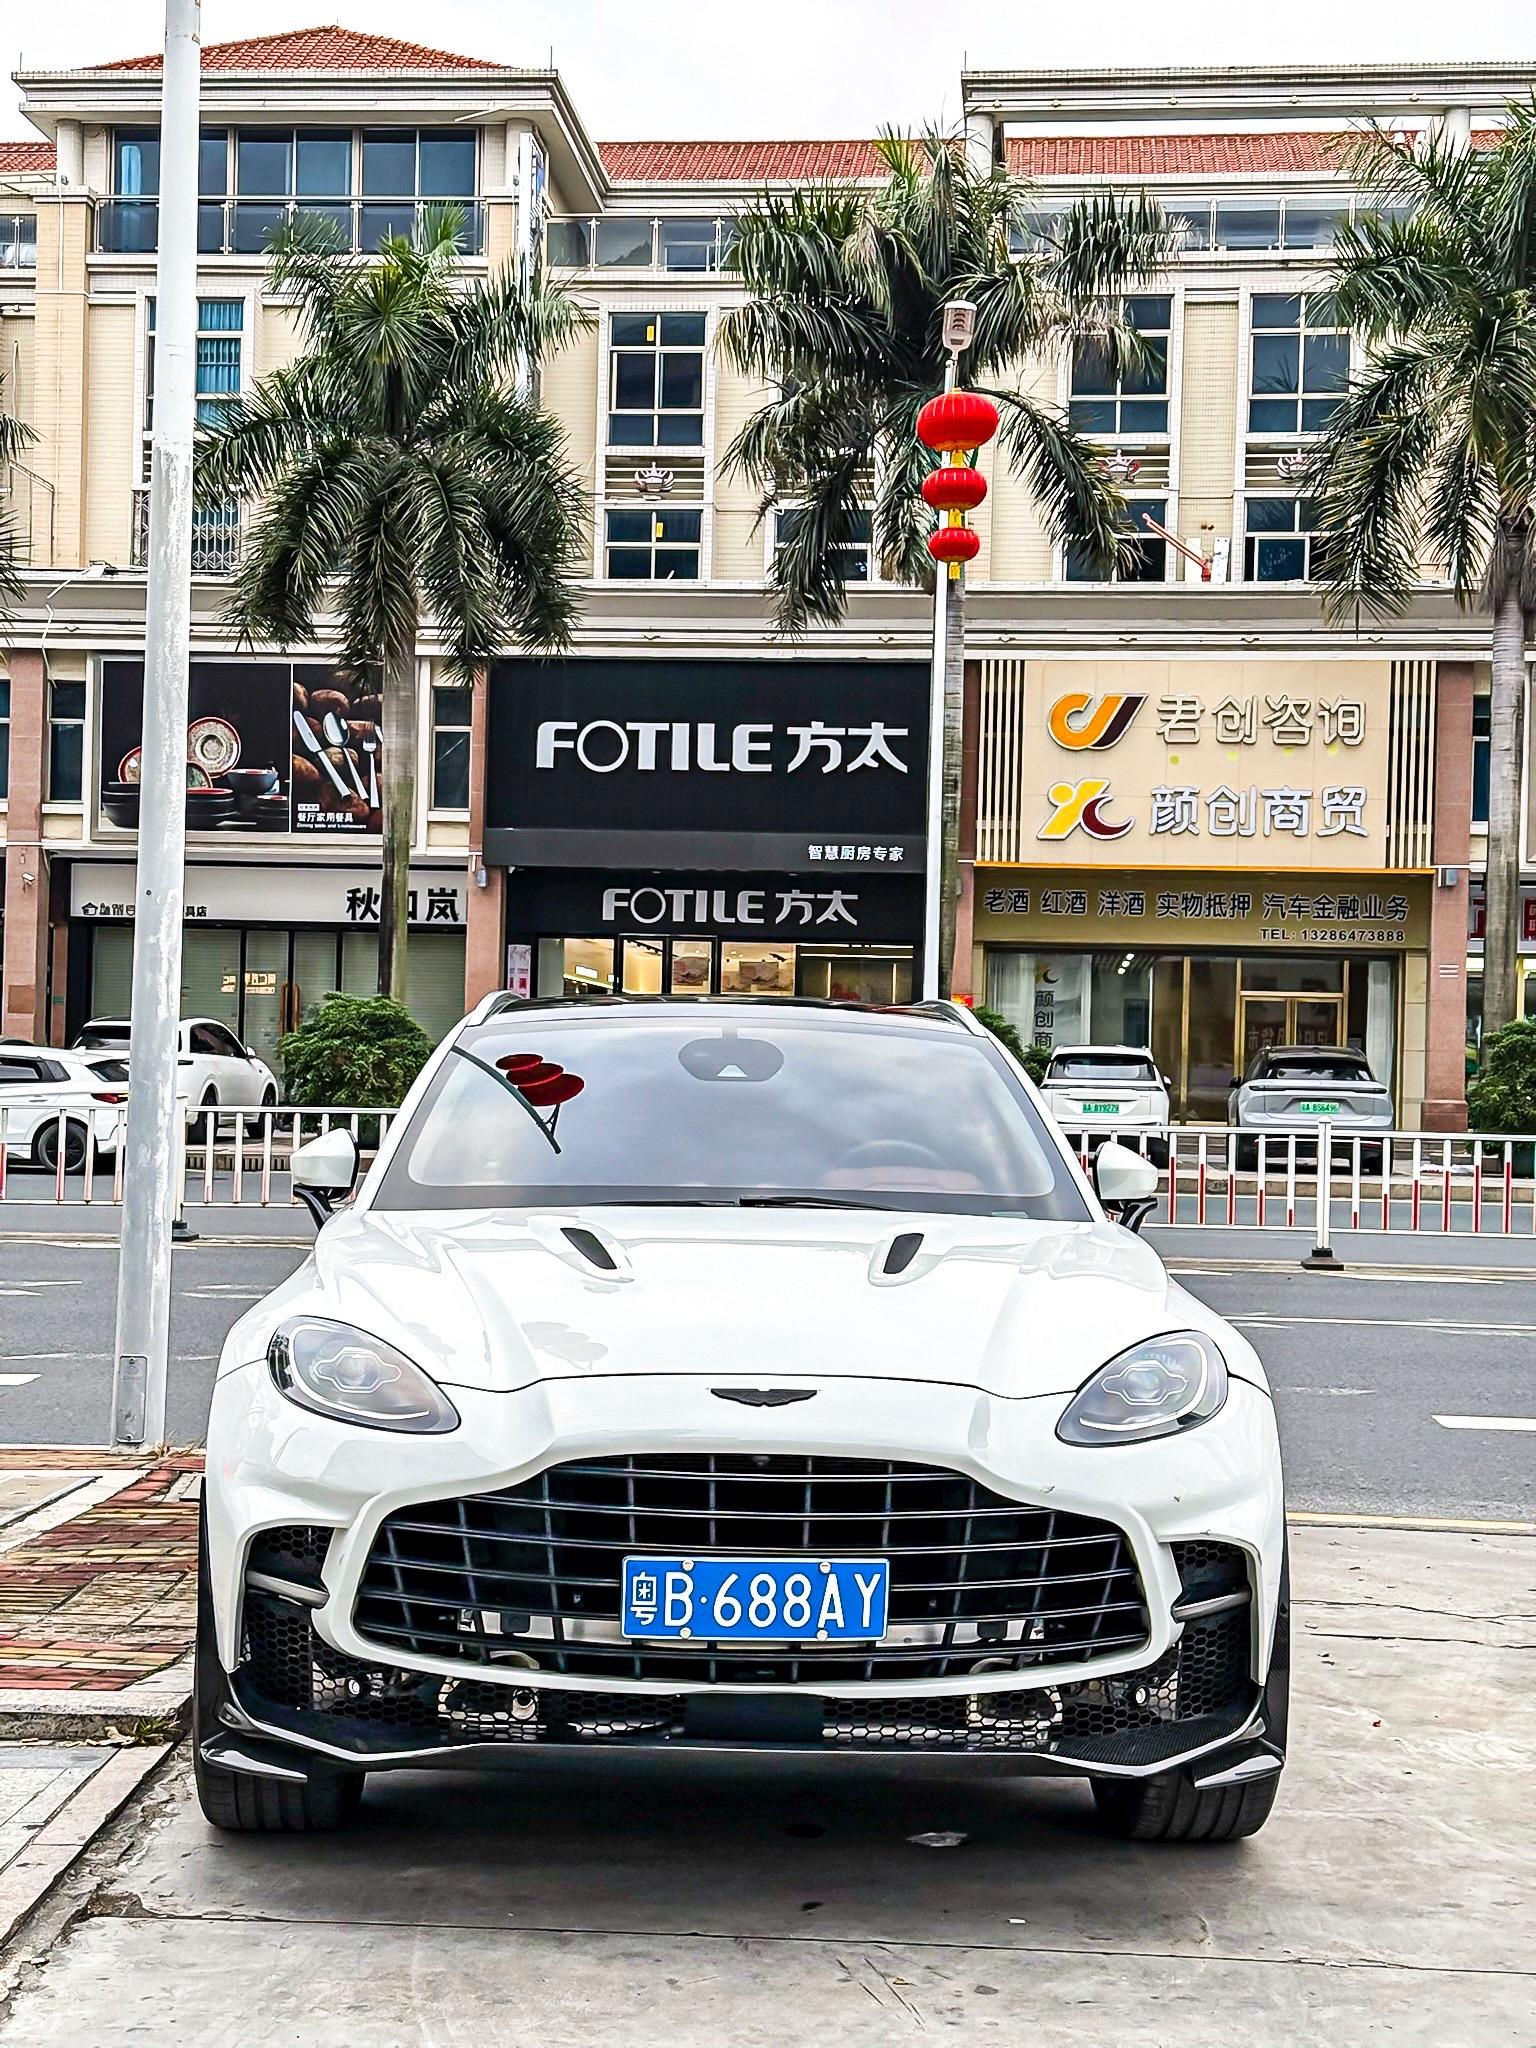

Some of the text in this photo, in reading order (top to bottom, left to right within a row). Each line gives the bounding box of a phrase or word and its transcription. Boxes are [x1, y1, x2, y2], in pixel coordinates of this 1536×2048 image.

[1156, 694, 1366, 745] 君创咨询
[536, 720, 909, 774] FOTILE 方太
[1149, 784, 1368, 838] 颜创商贸
[808, 844, 904, 862] 智慧厨房专家
[346, 887, 459, 922] 秋岚
[602, 887, 859, 926] FOTILE 方太
[984, 889, 1410, 922] 老酒 红酒 洋酒 实物抵押 汽车金融业务
[1260, 928, 1405, 943] TEL: 13286473888
[629, 1570, 882, 1629] 粤B·688AY
